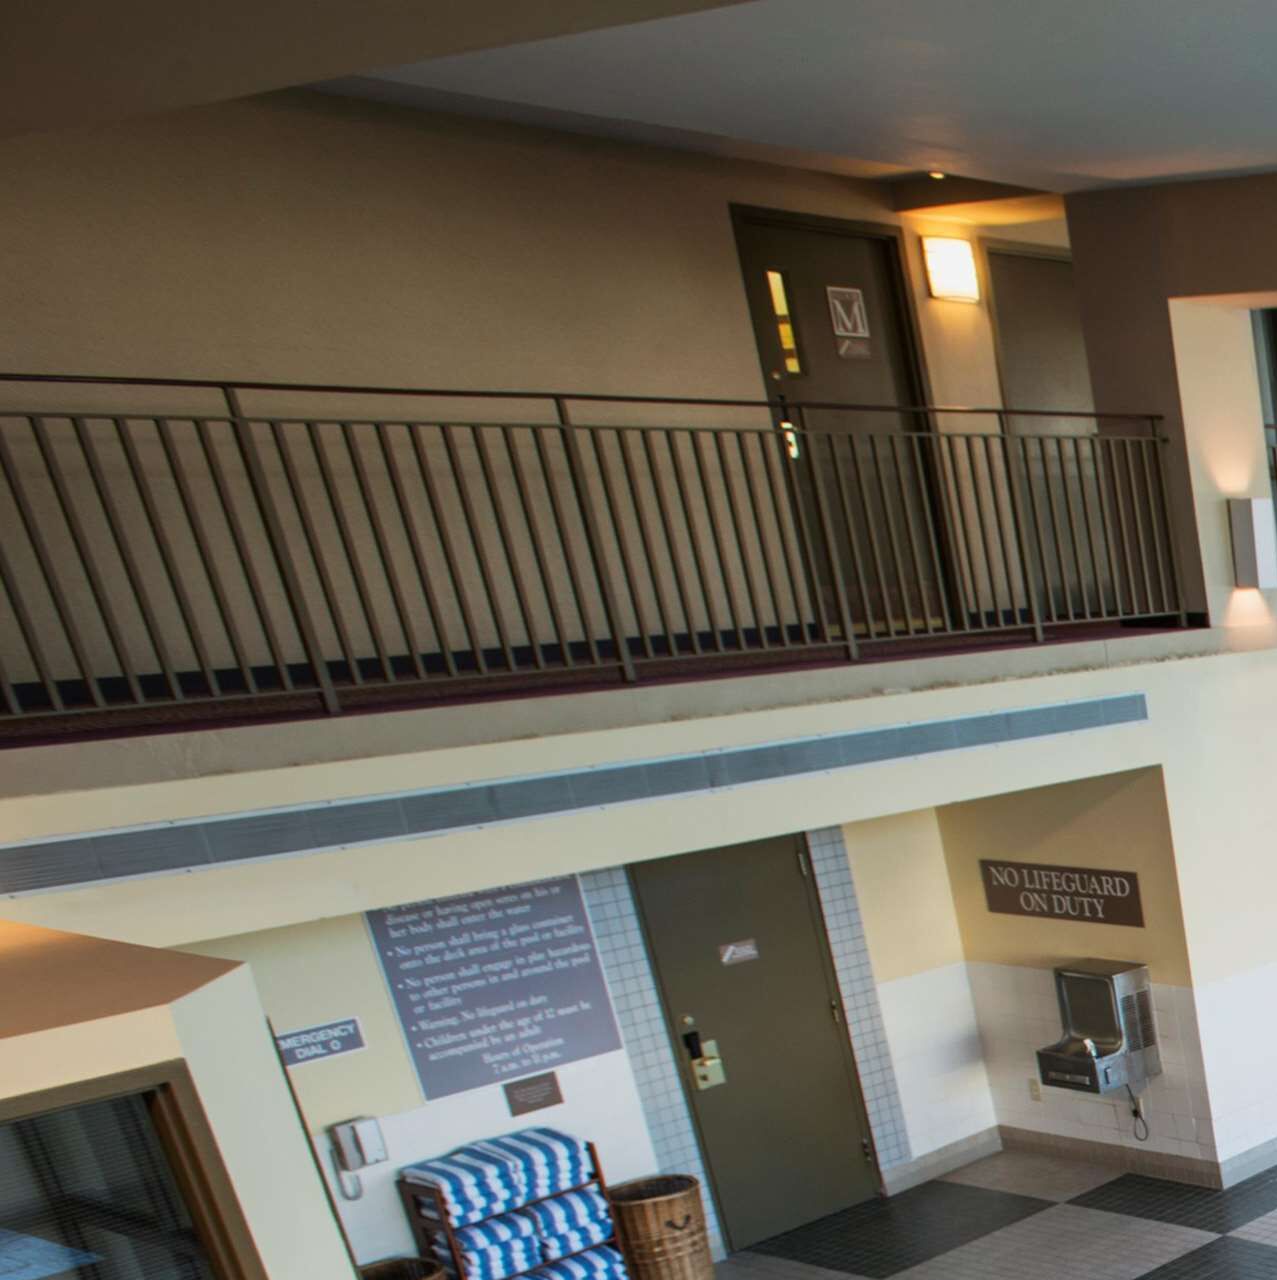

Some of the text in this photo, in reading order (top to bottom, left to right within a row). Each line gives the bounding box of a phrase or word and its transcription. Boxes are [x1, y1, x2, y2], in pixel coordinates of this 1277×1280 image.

[832, 298, 865, 333] M
[989, 866, 1130, 897] NO LIFEGUARD
[1020, 891, 1105, 918] ON DUTY
[278, 1023, 355, 1050] MERGENCY
[295, 1044, 328, 1060] DIAL
